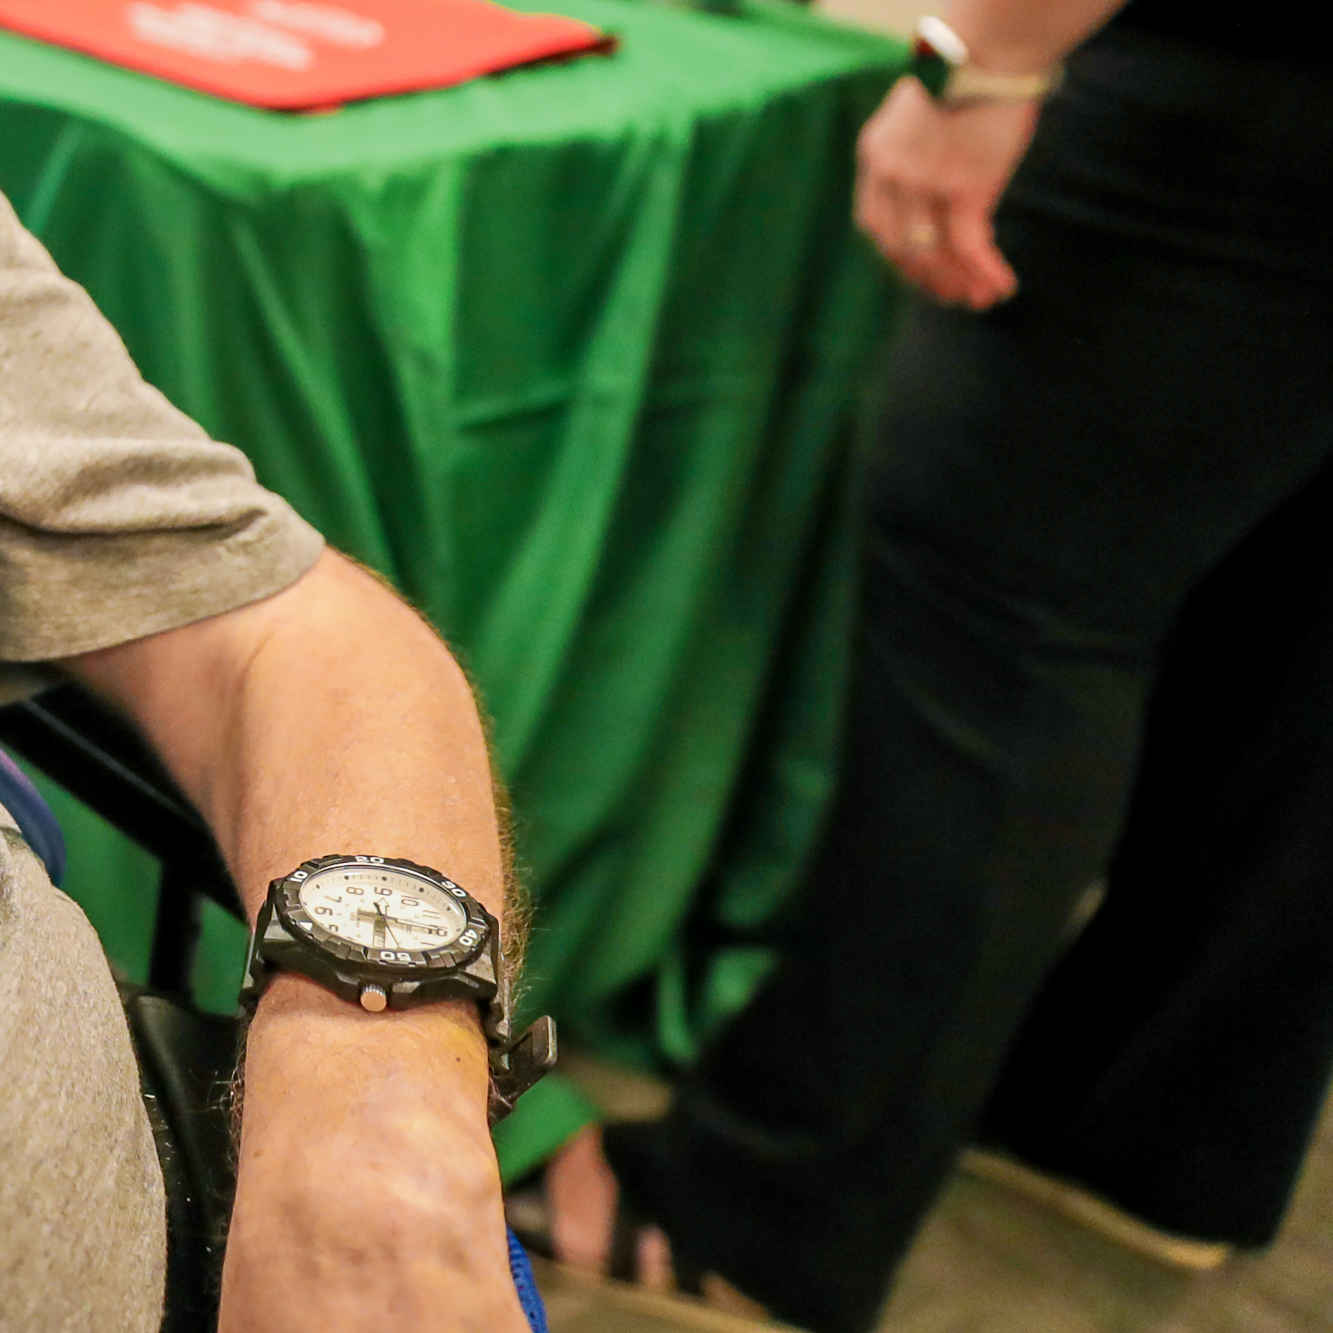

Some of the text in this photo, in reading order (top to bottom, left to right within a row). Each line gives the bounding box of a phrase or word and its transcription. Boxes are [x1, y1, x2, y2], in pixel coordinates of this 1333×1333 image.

[441, 880, 467, 898] 30
[459, 928, 478, 946] 40
[380, 951, 411, 962] 50
